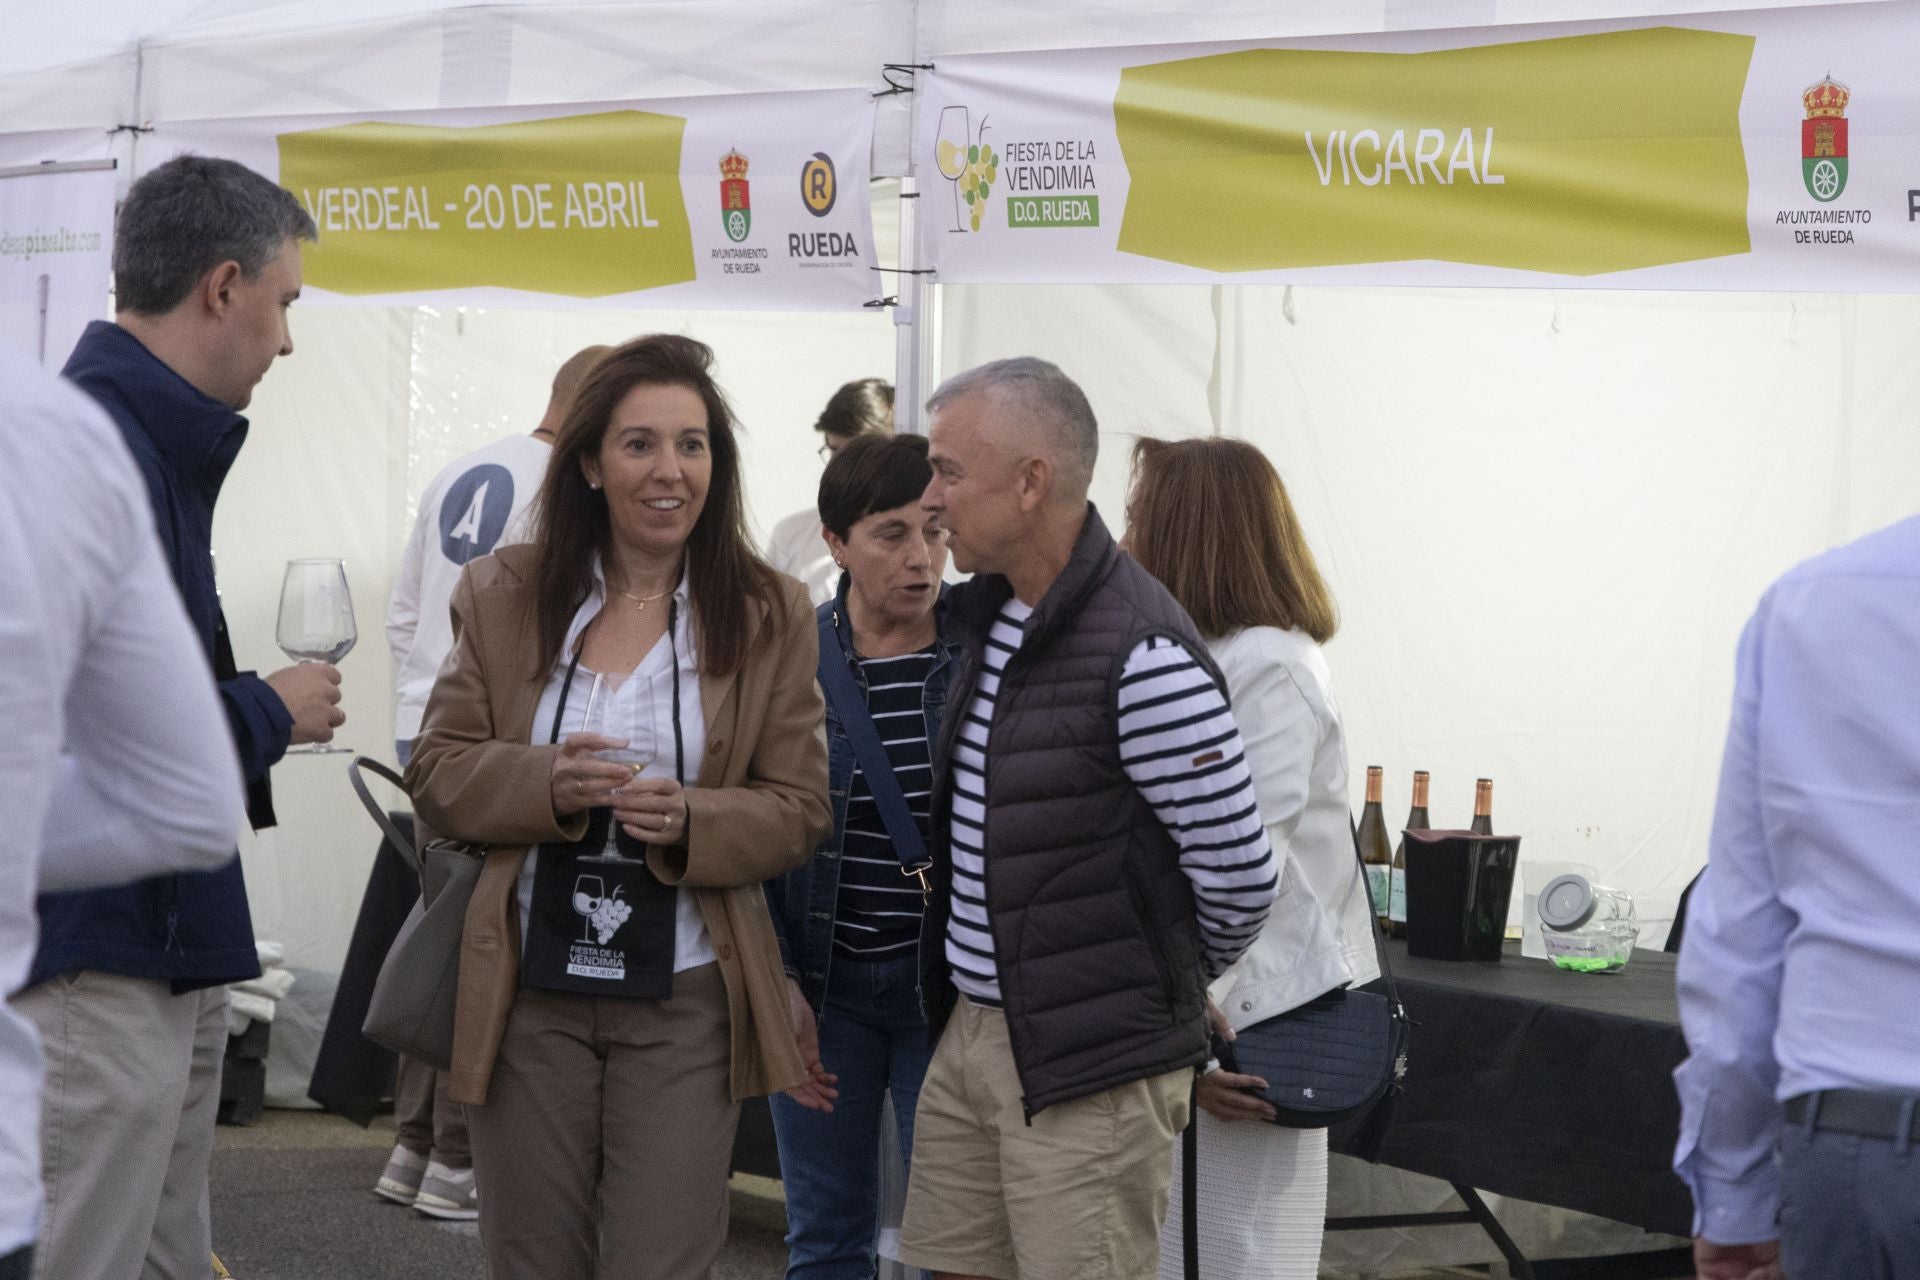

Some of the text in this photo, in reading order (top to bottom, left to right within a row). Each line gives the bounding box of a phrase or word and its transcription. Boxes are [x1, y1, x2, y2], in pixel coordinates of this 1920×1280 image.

[1006, 139, 1096, 163] FIESTA DE LA
[1304, 127, 1505, 186] VICARAL
[811, 168, 827, 200] R
[1005, 165, 1096, 191] VENDIMIA
[304, 181, 660, 231] VERDEAL - 20 DE ABRIL
[1014, 200, 1092, 222] D.O. RUEDA
[1775, 210, 1872, 225] AYUNTAMIENTO
[788, 232, 859, 257] RUEDA
[1794, 230, 1855, 244] DE RUEDA
[711, 248, 768, 260] AYUNTAMIENTO
[723, 262, 761, 274] DE RUEDA
[449, 479, 490, 545] A
[570, 946, 625, 959] FIESTA DE LA
[570, 954, 625, 969] VENDIMIA
[590, 967, 620, 977] RUEDA
